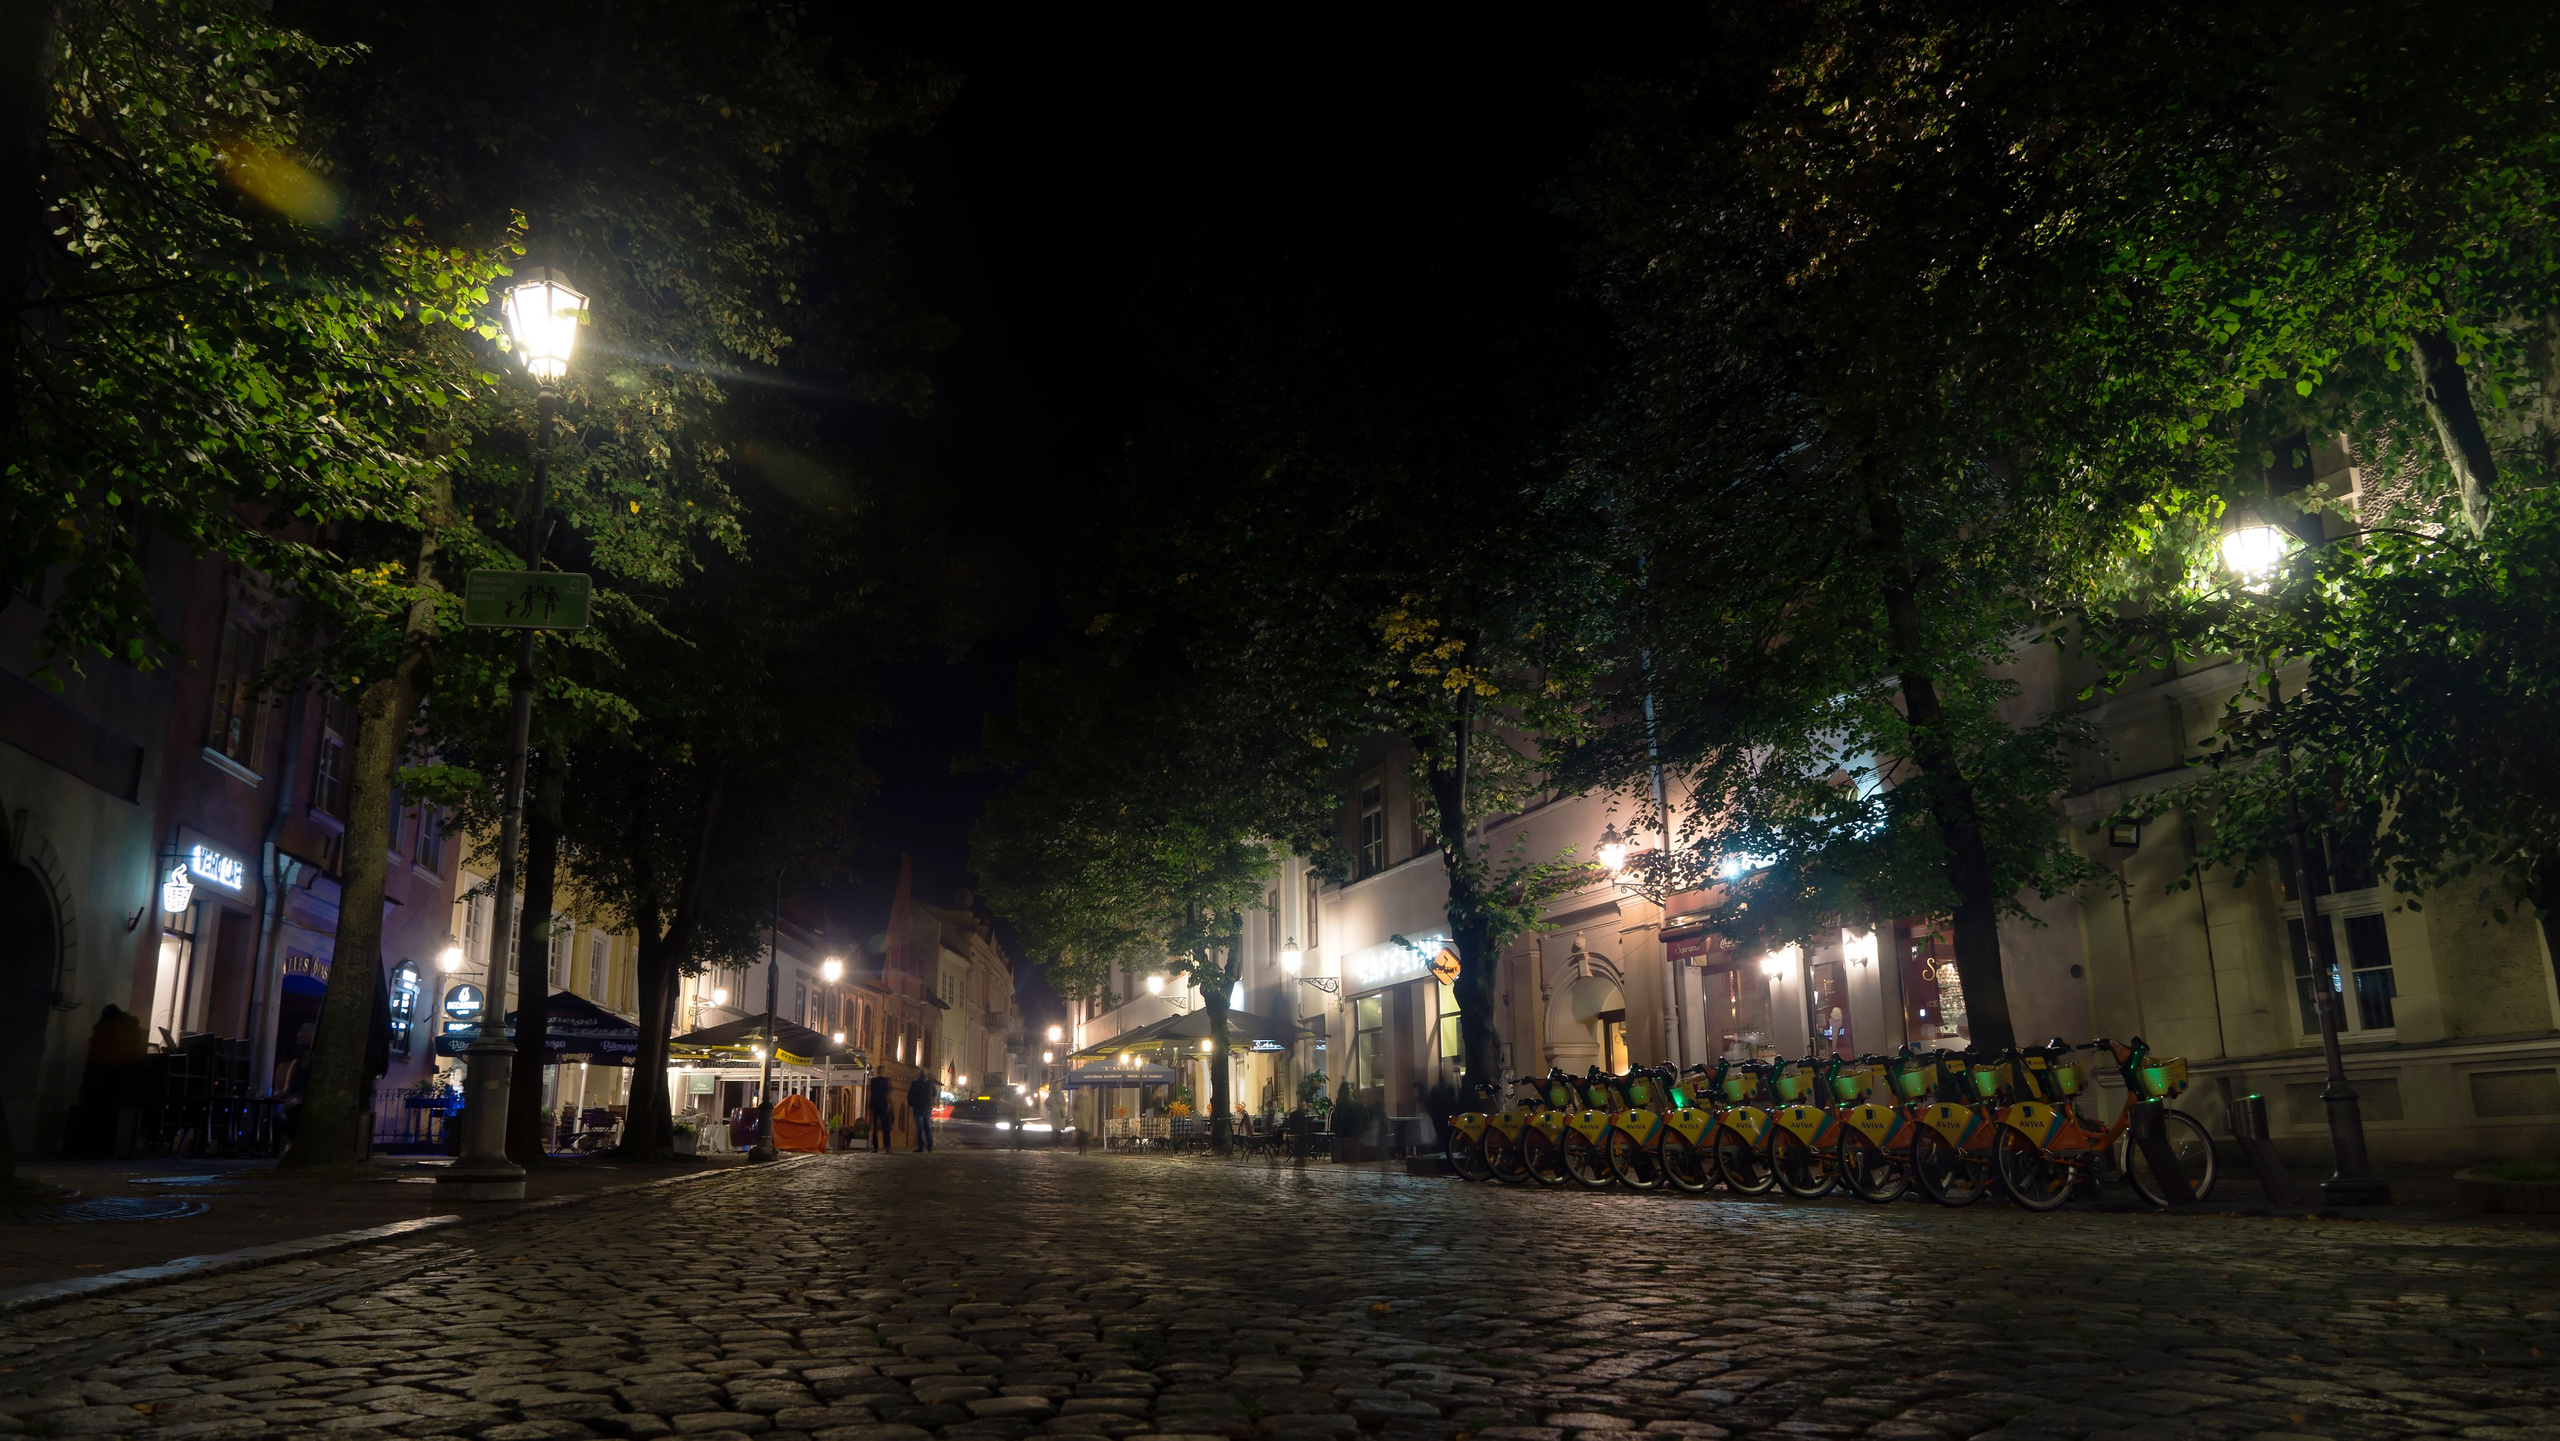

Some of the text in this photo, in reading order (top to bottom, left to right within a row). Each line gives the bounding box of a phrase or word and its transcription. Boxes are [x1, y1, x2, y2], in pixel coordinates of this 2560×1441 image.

[448, 1039, 471, 1052] Vilk
[600, 1040, 638, 1052] Vilkmergė
[1790, 1122, 1815, 1130] AVIVA
[1861, 1121, 1885, 1130] AVIVA
[1935, 1121, 1961, 1130] AVIVA
[2019, 1120, 2046, 1129] AVIVA
